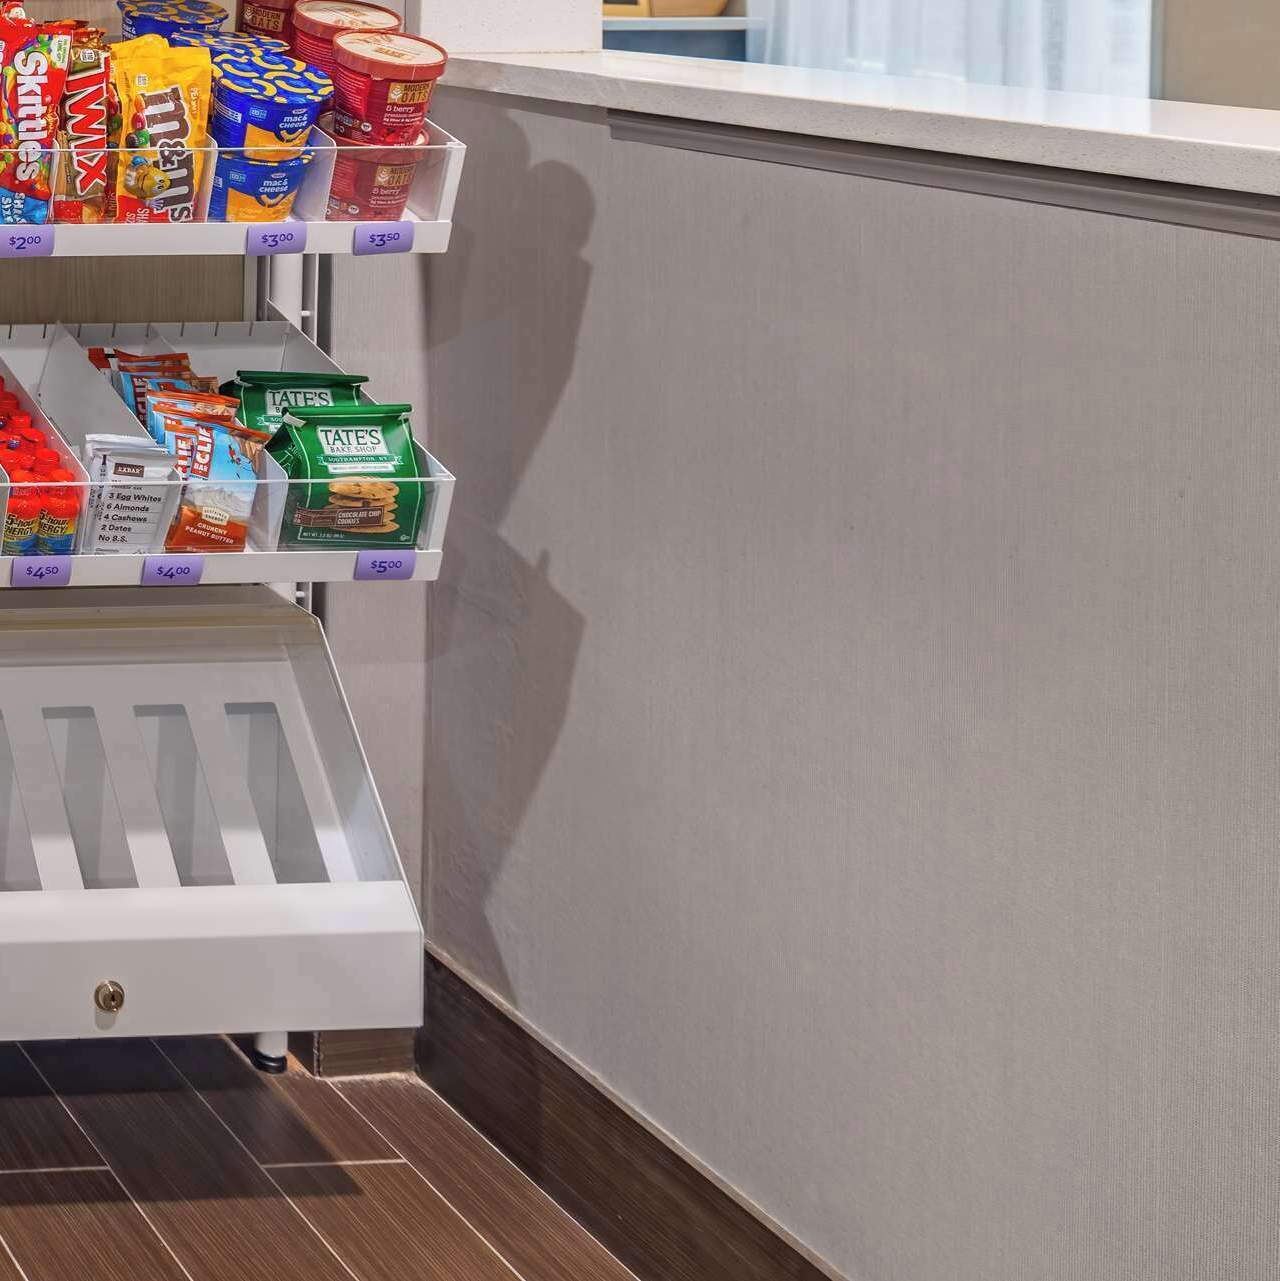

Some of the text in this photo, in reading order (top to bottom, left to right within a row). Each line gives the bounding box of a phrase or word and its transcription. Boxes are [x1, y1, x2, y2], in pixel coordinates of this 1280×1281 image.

[270, 390, 330, 407] TATE'S
[320, 428, 381, 446] TATE'S
[330, 445, 377, 454] BAKE SHOP
[192, 462, 208, 477] BAR
[108, 492, 162, 503] 3 Egg Whites
[106, 502, 150, 513] 6 Almonds
[104, 513, 147, 523] 4 Cashews
[108, 524, 132, 533] Dates
[197, 521, 228, 535] CRUNCHY
[185, 525, 234, 545] PEANUT BUTTER
